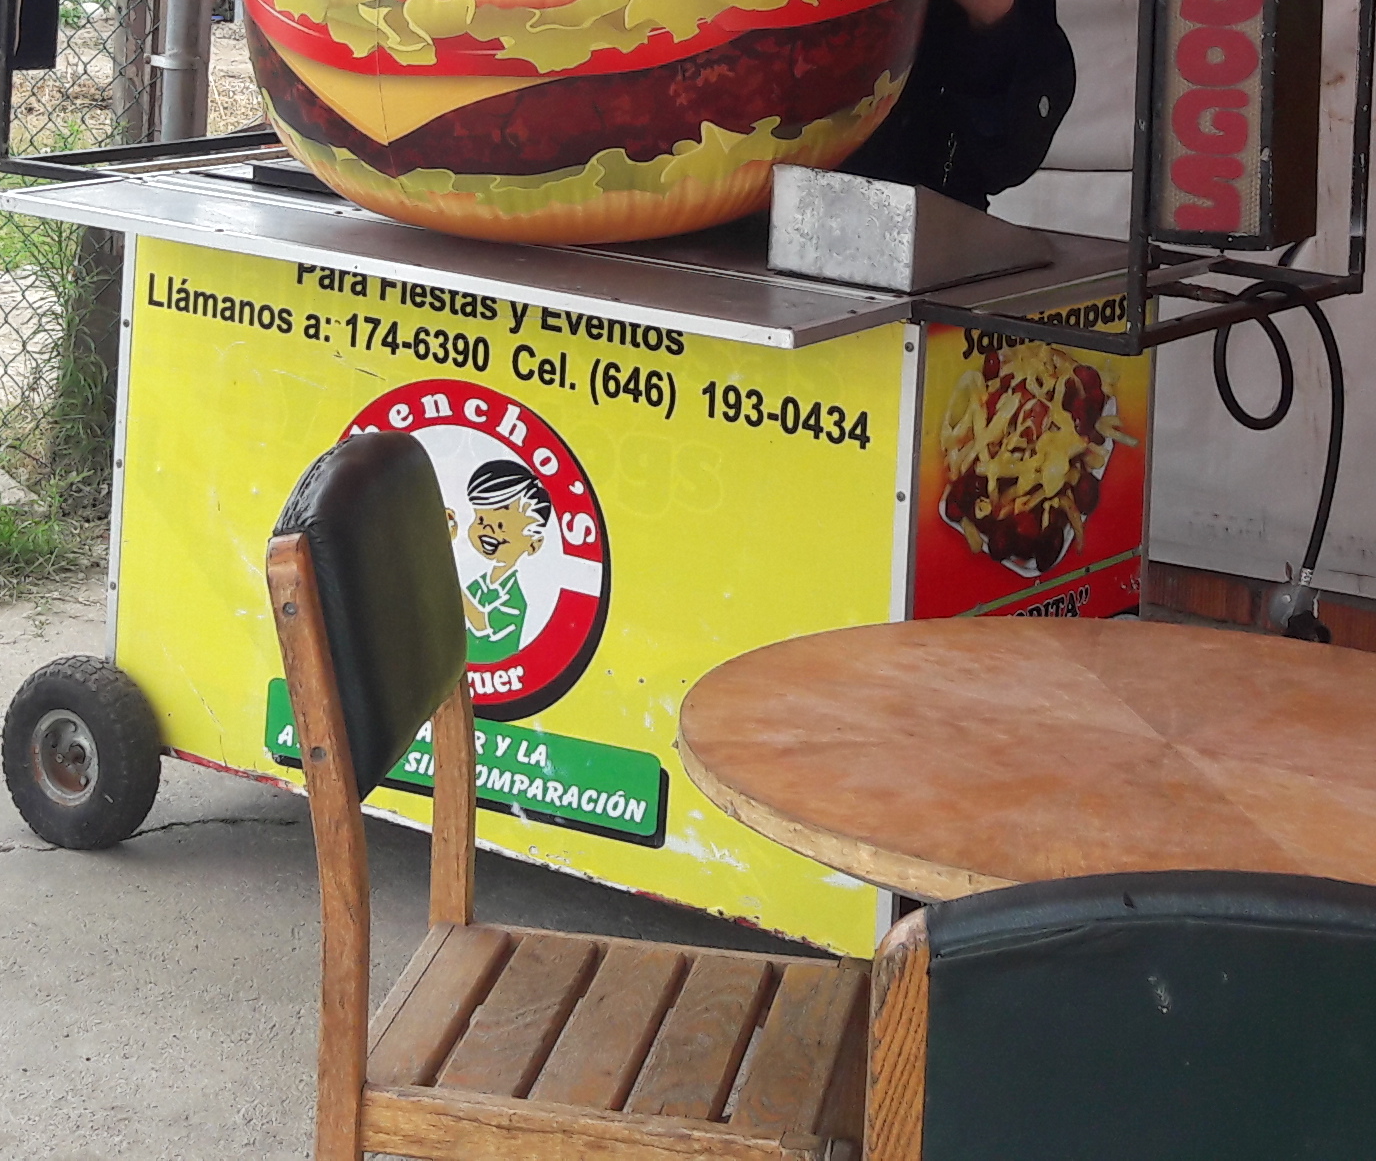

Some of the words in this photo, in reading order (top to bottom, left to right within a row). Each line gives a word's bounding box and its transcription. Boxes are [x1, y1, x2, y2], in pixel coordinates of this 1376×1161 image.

[296, 263, 369, 298] Para
[379, 277, 499, 321] Fiestas
[508, 300, 530, 333] y
[539, 307, 686, 356] Eventos
[146, 272, 293, 334] Llámanos
[303, 314, 334, 343] a:
[344, 313, 490, 373] 174-6390
[512, 344, 578, 391] Cel.
[589, 357, 678, 420] (646)
[703, 381, 871, 450] 193-0434
[495, 737, 514, 758] Y
[516, 739, 548, 768] LA
